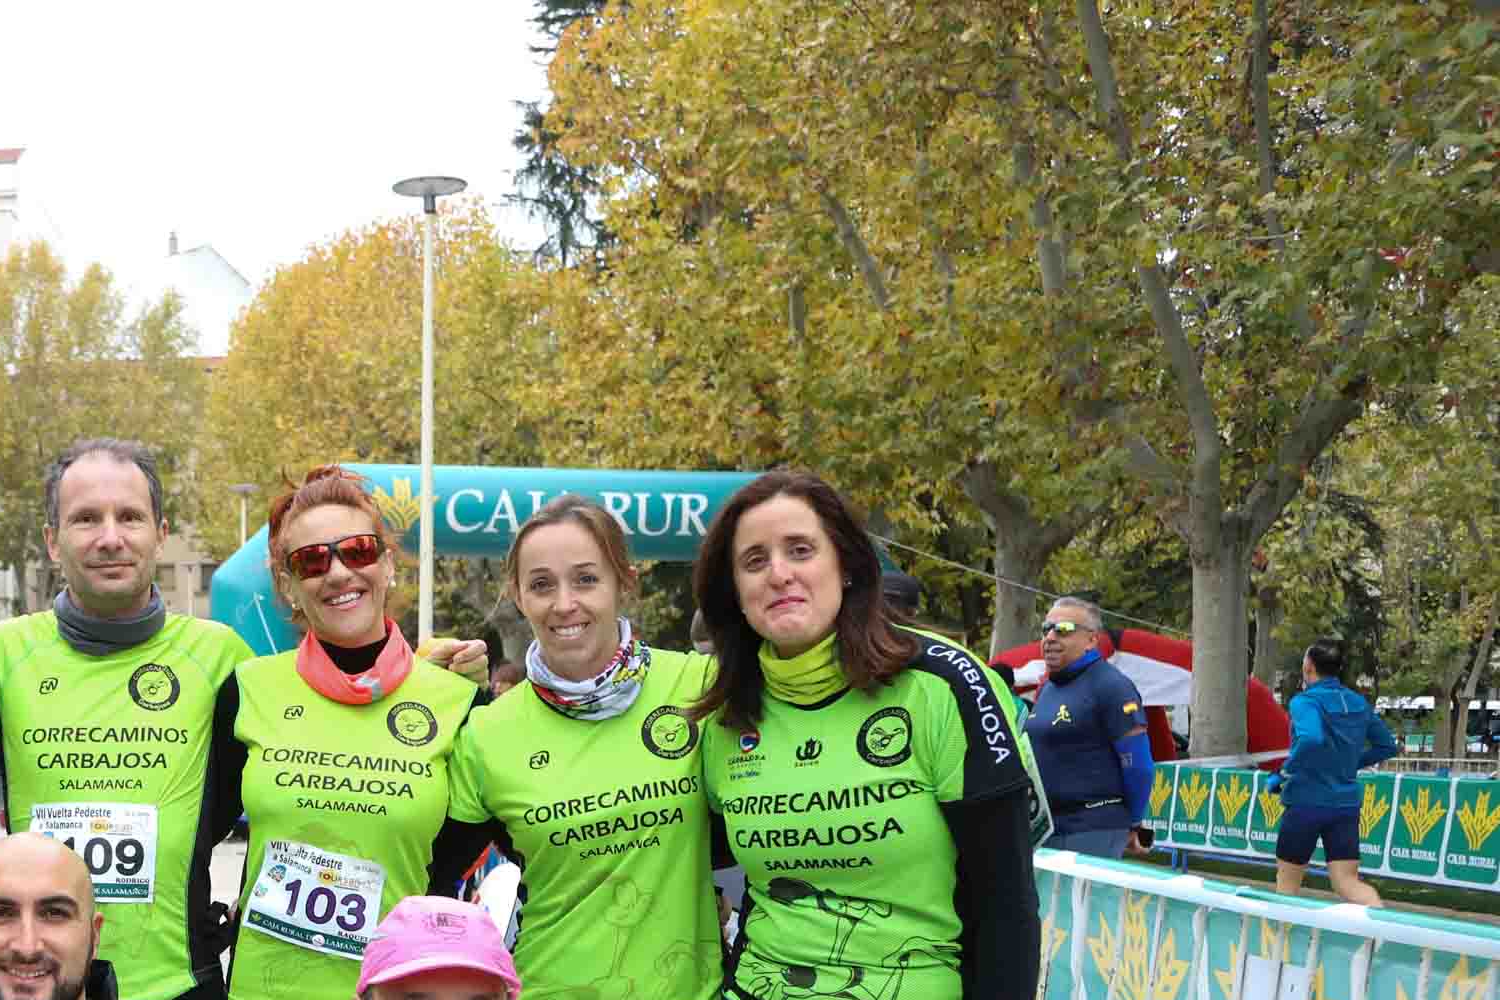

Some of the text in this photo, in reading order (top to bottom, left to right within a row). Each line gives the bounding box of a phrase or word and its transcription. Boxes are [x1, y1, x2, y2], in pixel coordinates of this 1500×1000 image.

[446, 488, 572, 535] CAJ
[926, 644, 1011, 764] CARBAJOSA
[22, 727, 188, 745] CORRECAMINOS
[37, 752, 167, 769] CARBAJOSA
[262, 748, 433, 778] CORRECAMINOS
[59, 779, 143, 790] SALAMANCA
[275, 771, 414, 799] CARBAJOSA
[724, 779, 926, 816] CORRECAMINOS
[36, 808, 111, 818] VII Vuelta Pedestre
[296, 797, 387, 816] SALAMANCA
[524, 775, 698, 826] CORRECAMINOS
[45, 821, 83, 830] Salamanca
[549, 808, 684, 847] CARBAJOSA
[735, 817, 904, 849] CARBAJOSA
[270, 841, 282, 850] VII
[283, 842, 309, 859] Vlta
[579, 835, 660, 861] SALAMANCA
[280, 854, 312, 874] Salamanca
[764, 857, 873, 871] SALAMANCA
[284, 879, 367, 932] 103
[263, 919, 280, 931] CAJA
[281, 925, 305, 939] RURAL
[326, 938, 365, 953] LAMANCA
